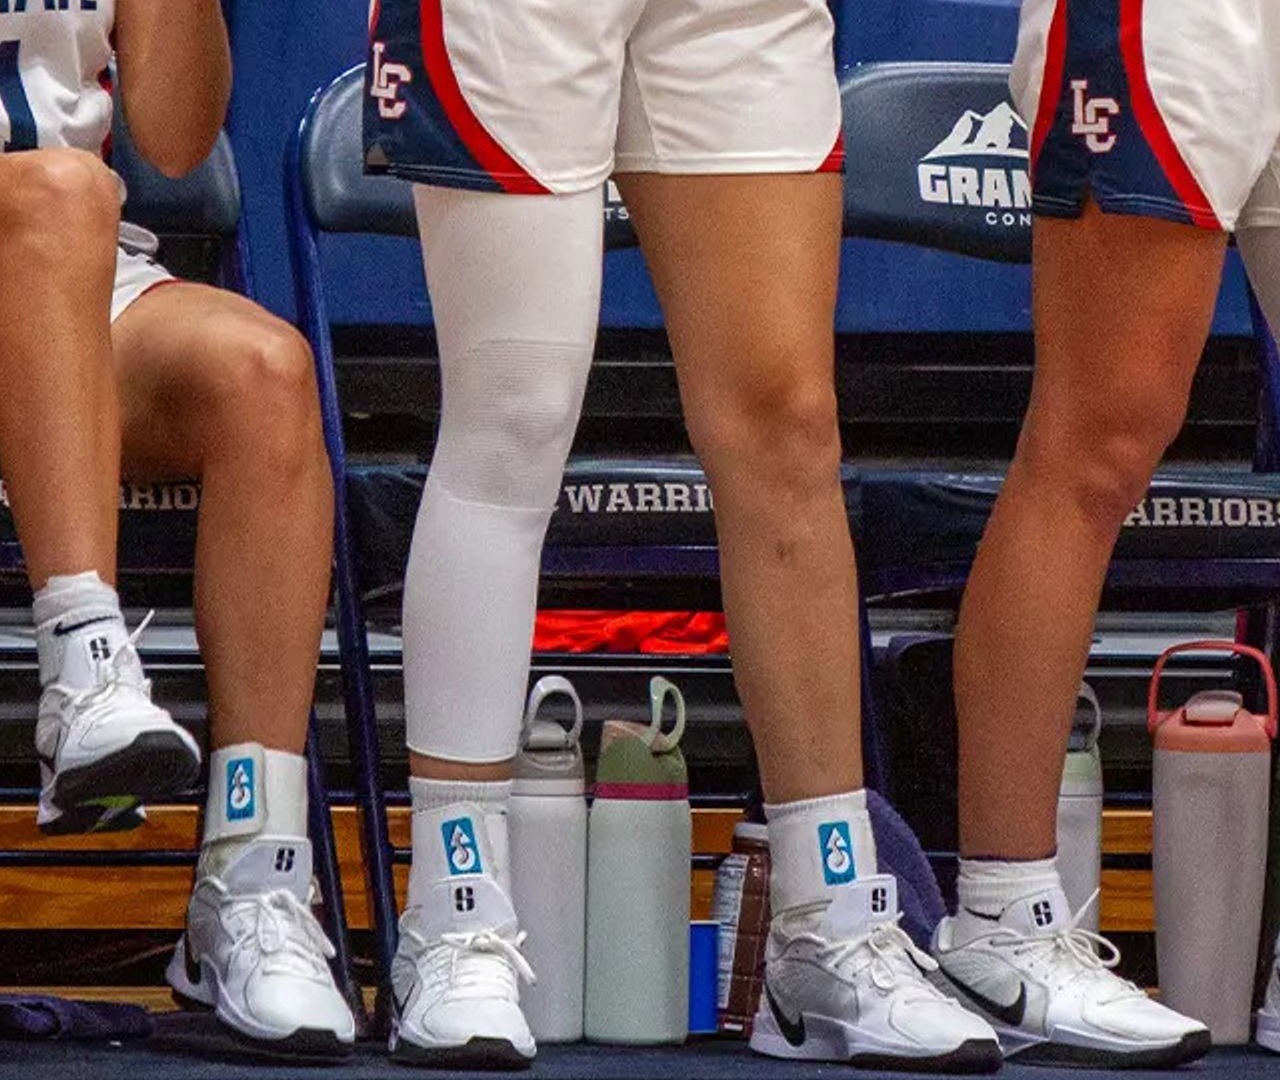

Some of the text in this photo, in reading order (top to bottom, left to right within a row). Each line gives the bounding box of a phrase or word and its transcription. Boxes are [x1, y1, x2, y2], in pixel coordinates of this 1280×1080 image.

[369, 41, 412, 120] LC
[1070, 78, 1120, 154] LC
[917, 163, 1033, 210] GRAN
[563, 482, 715, 513] WARRI
